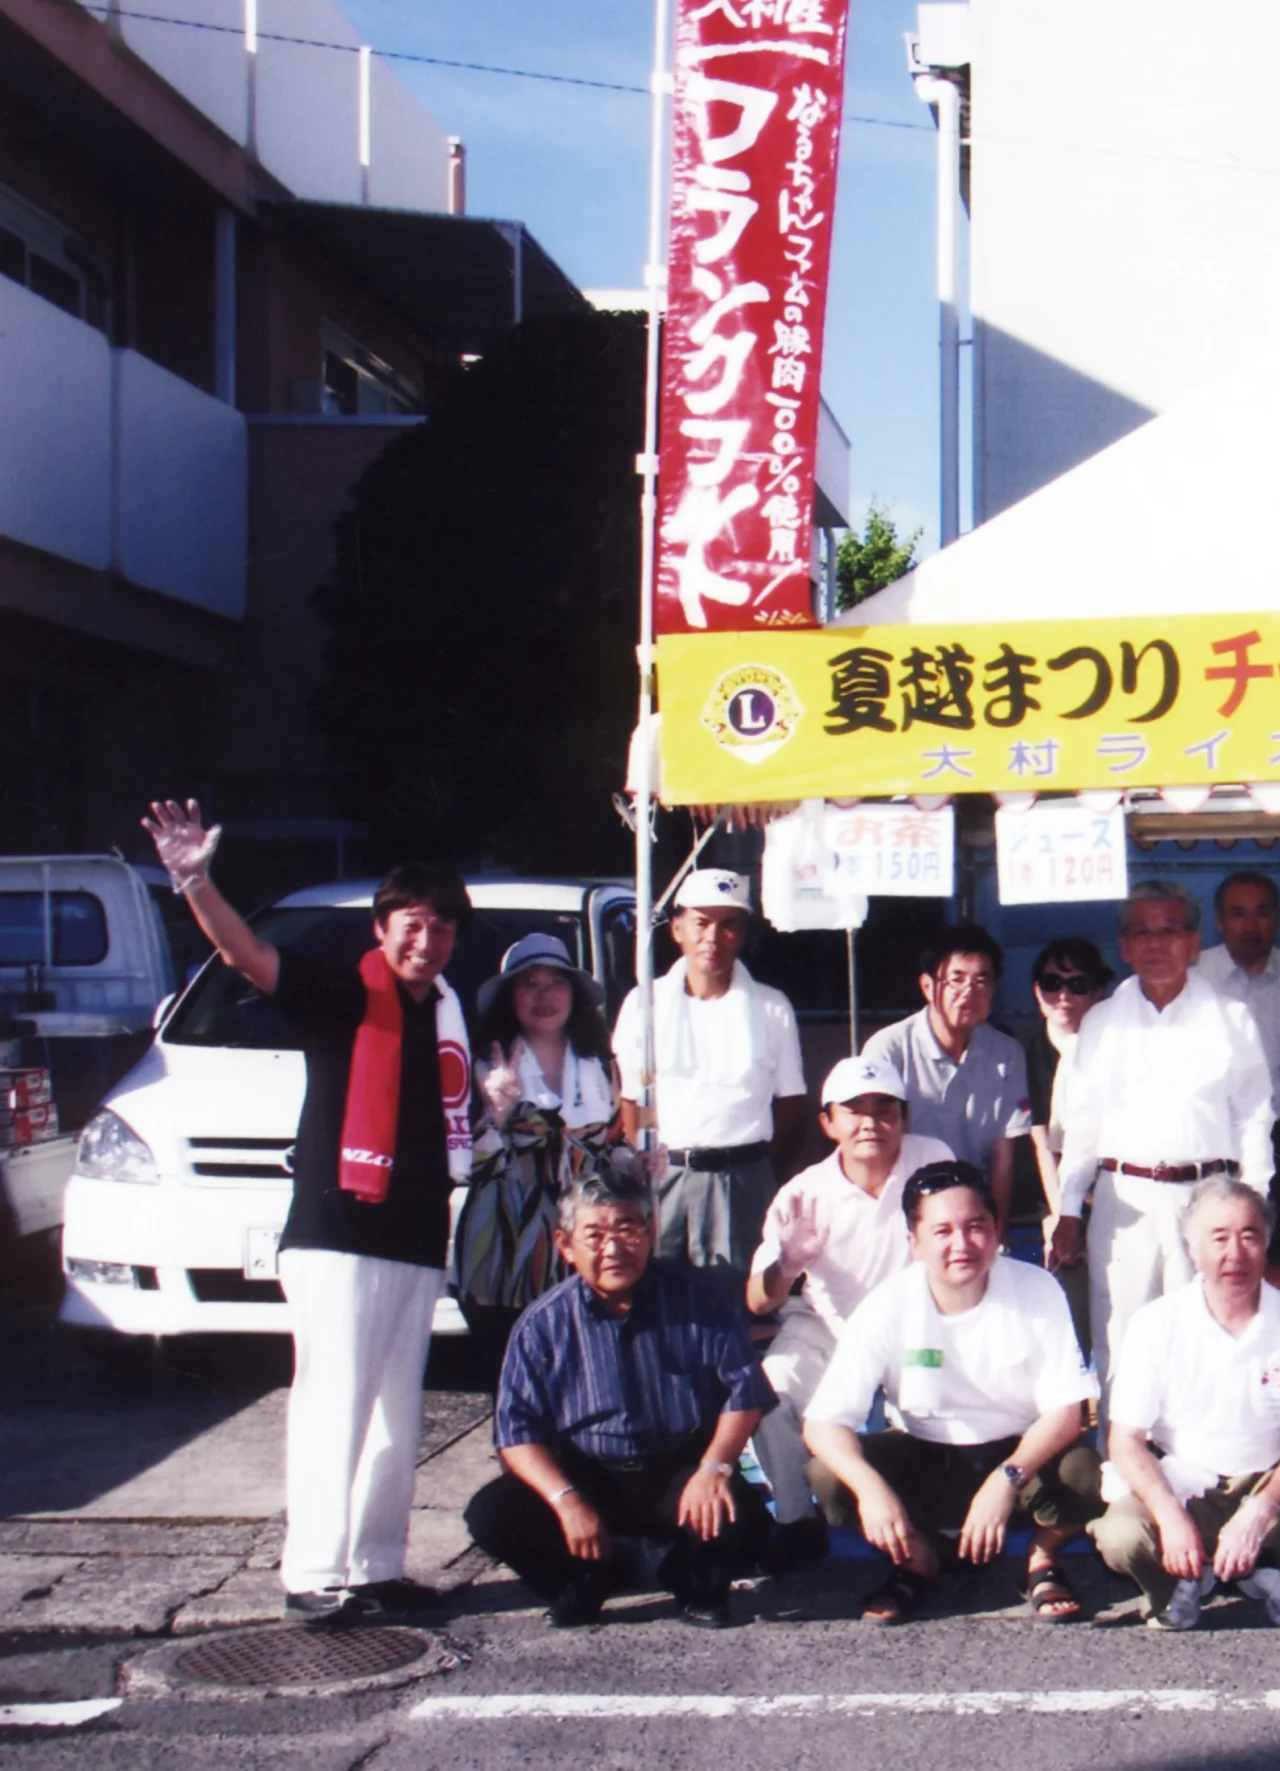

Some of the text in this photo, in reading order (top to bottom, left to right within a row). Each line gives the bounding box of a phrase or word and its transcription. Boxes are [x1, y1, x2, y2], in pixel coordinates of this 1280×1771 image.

[823, 638, 1181, 735] 夏越まつり
[837, 814, 943, 849] お茶
